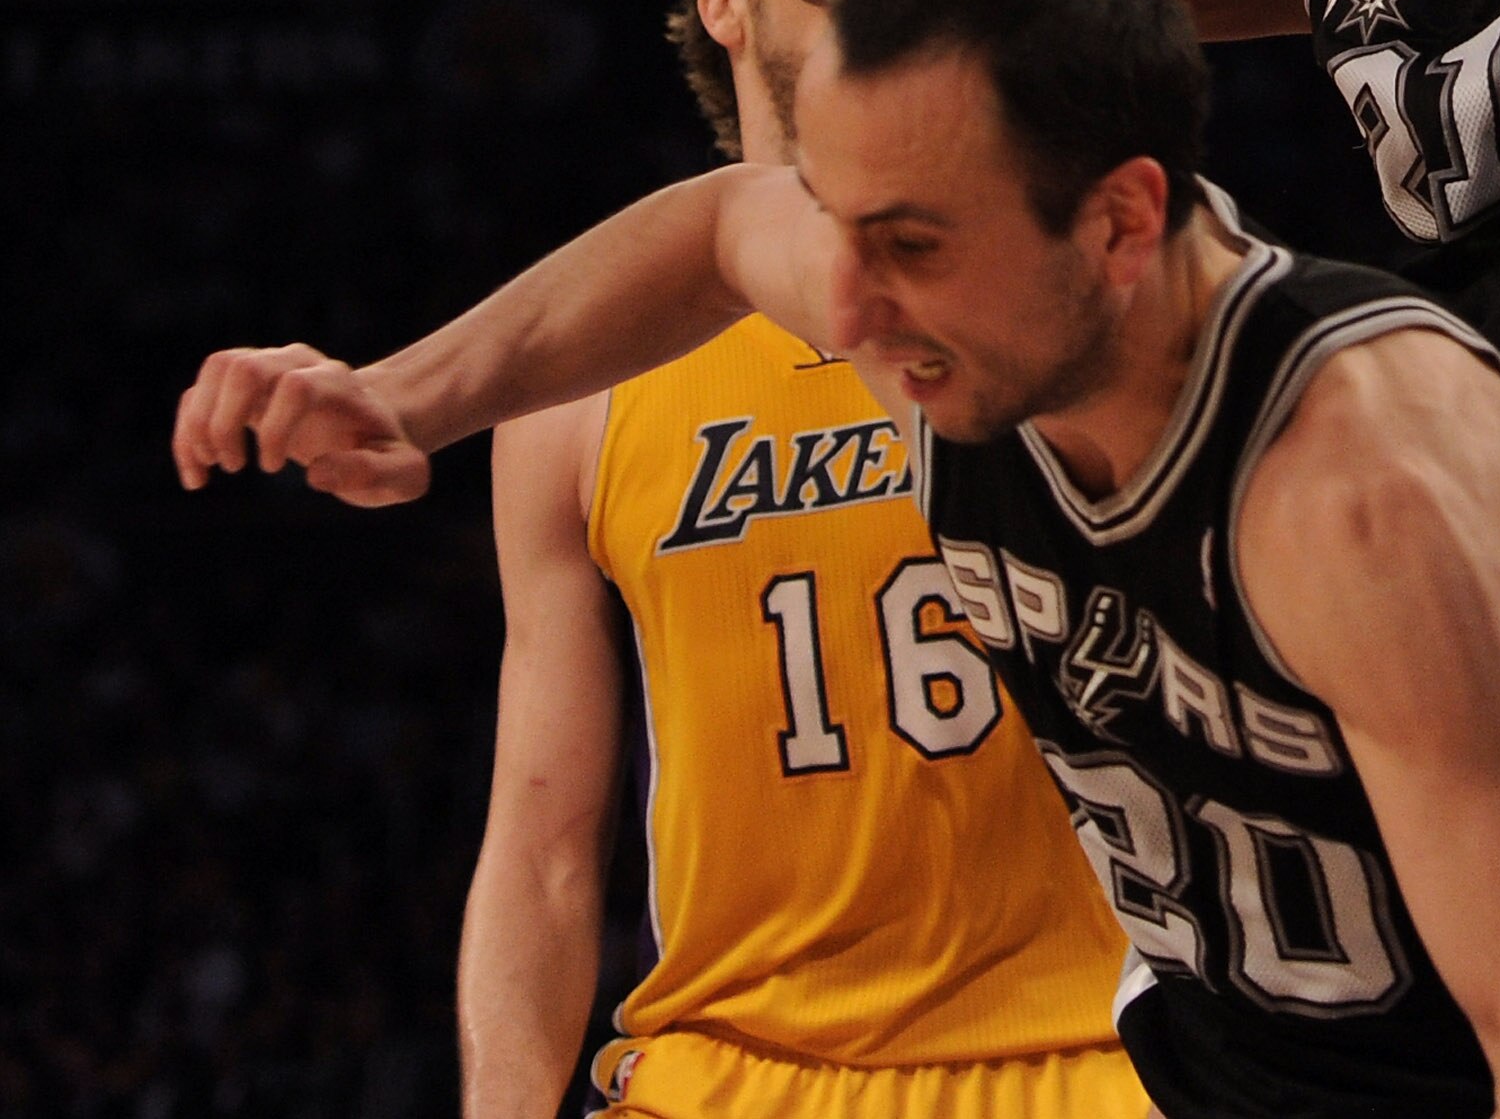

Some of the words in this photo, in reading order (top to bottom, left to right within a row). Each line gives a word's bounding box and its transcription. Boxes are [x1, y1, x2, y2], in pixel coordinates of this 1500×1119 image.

[760, 555, 1003, 777] 16
[938, 534, 1342, 778] SPURS
[1034, 737, 1412, 1019] 20
